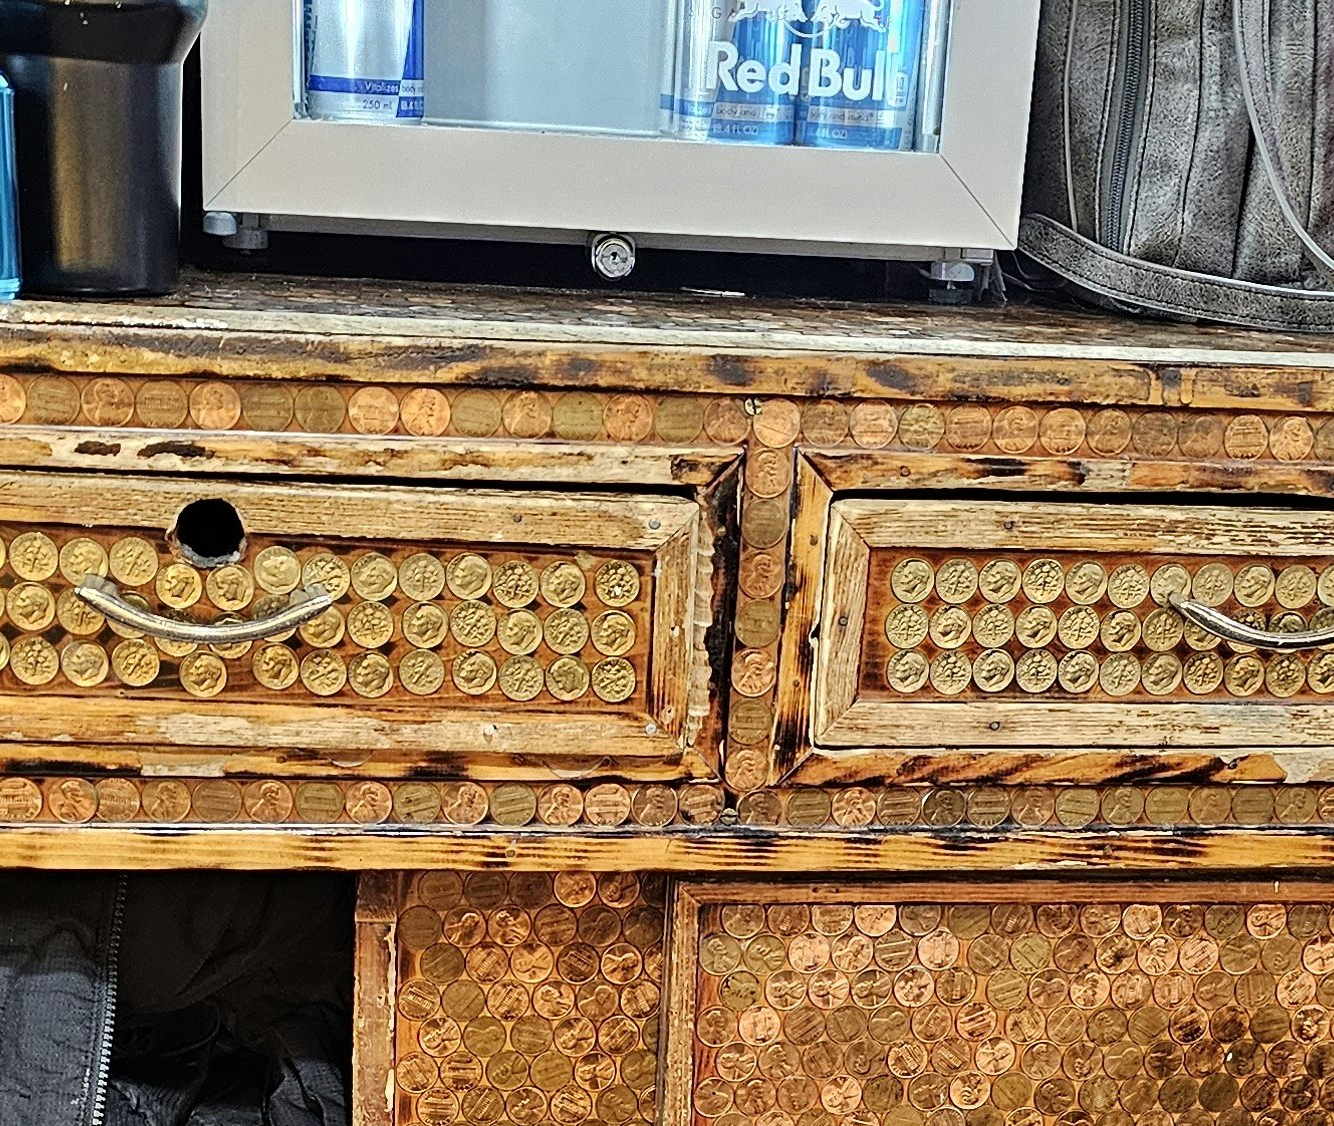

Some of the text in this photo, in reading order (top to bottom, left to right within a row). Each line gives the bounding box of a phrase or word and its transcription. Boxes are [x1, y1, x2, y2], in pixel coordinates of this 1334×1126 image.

[706, 41, 905, 106] Red Bull
[363, 99, 381, 110] 250
